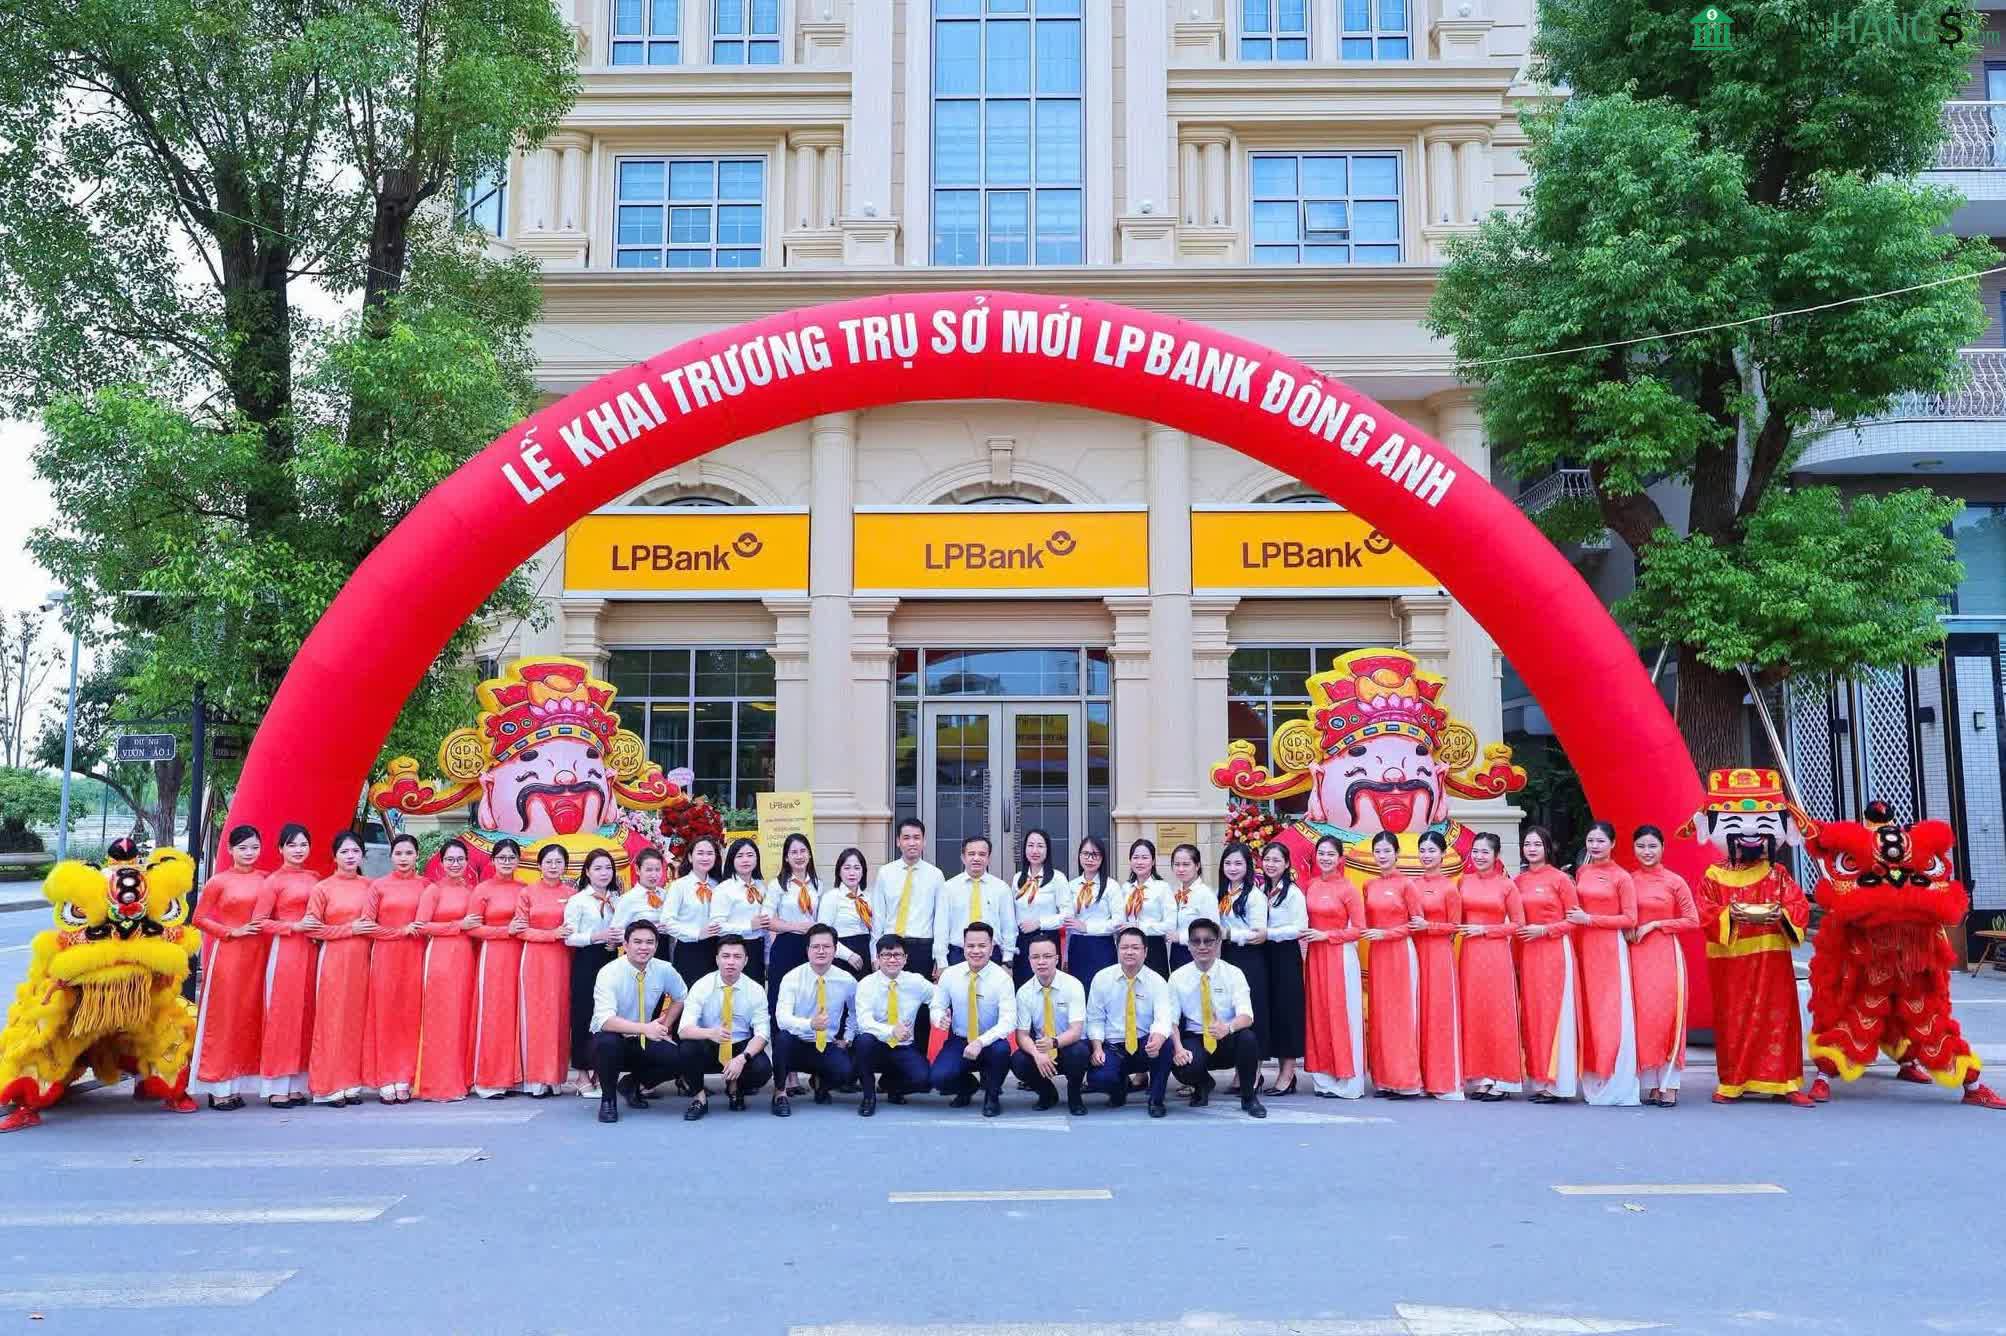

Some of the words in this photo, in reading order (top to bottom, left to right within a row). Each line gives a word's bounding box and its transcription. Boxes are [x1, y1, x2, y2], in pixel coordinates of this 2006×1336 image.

[502, 426, 565, 504] LỄ
[559, 383, 667, 466] KHAI
[660, 325, 832, 414] TRƯƠNG
[838, 312, 918, 368] TRỤ
[931, 294, 990, 354] SỞ
[1003, 303, 1082, 359] MỚI
[1094, 320, 1261, 403] LPBANK
[1260, 370, 1376, 456] ĐÔNG
[1366, 433, 1456, 507] ANH
[612, 544, 730, 571] LPBank
[925, 543, 1044, 569] LPBank
[1242, 542, 1362, 569] LPBank
